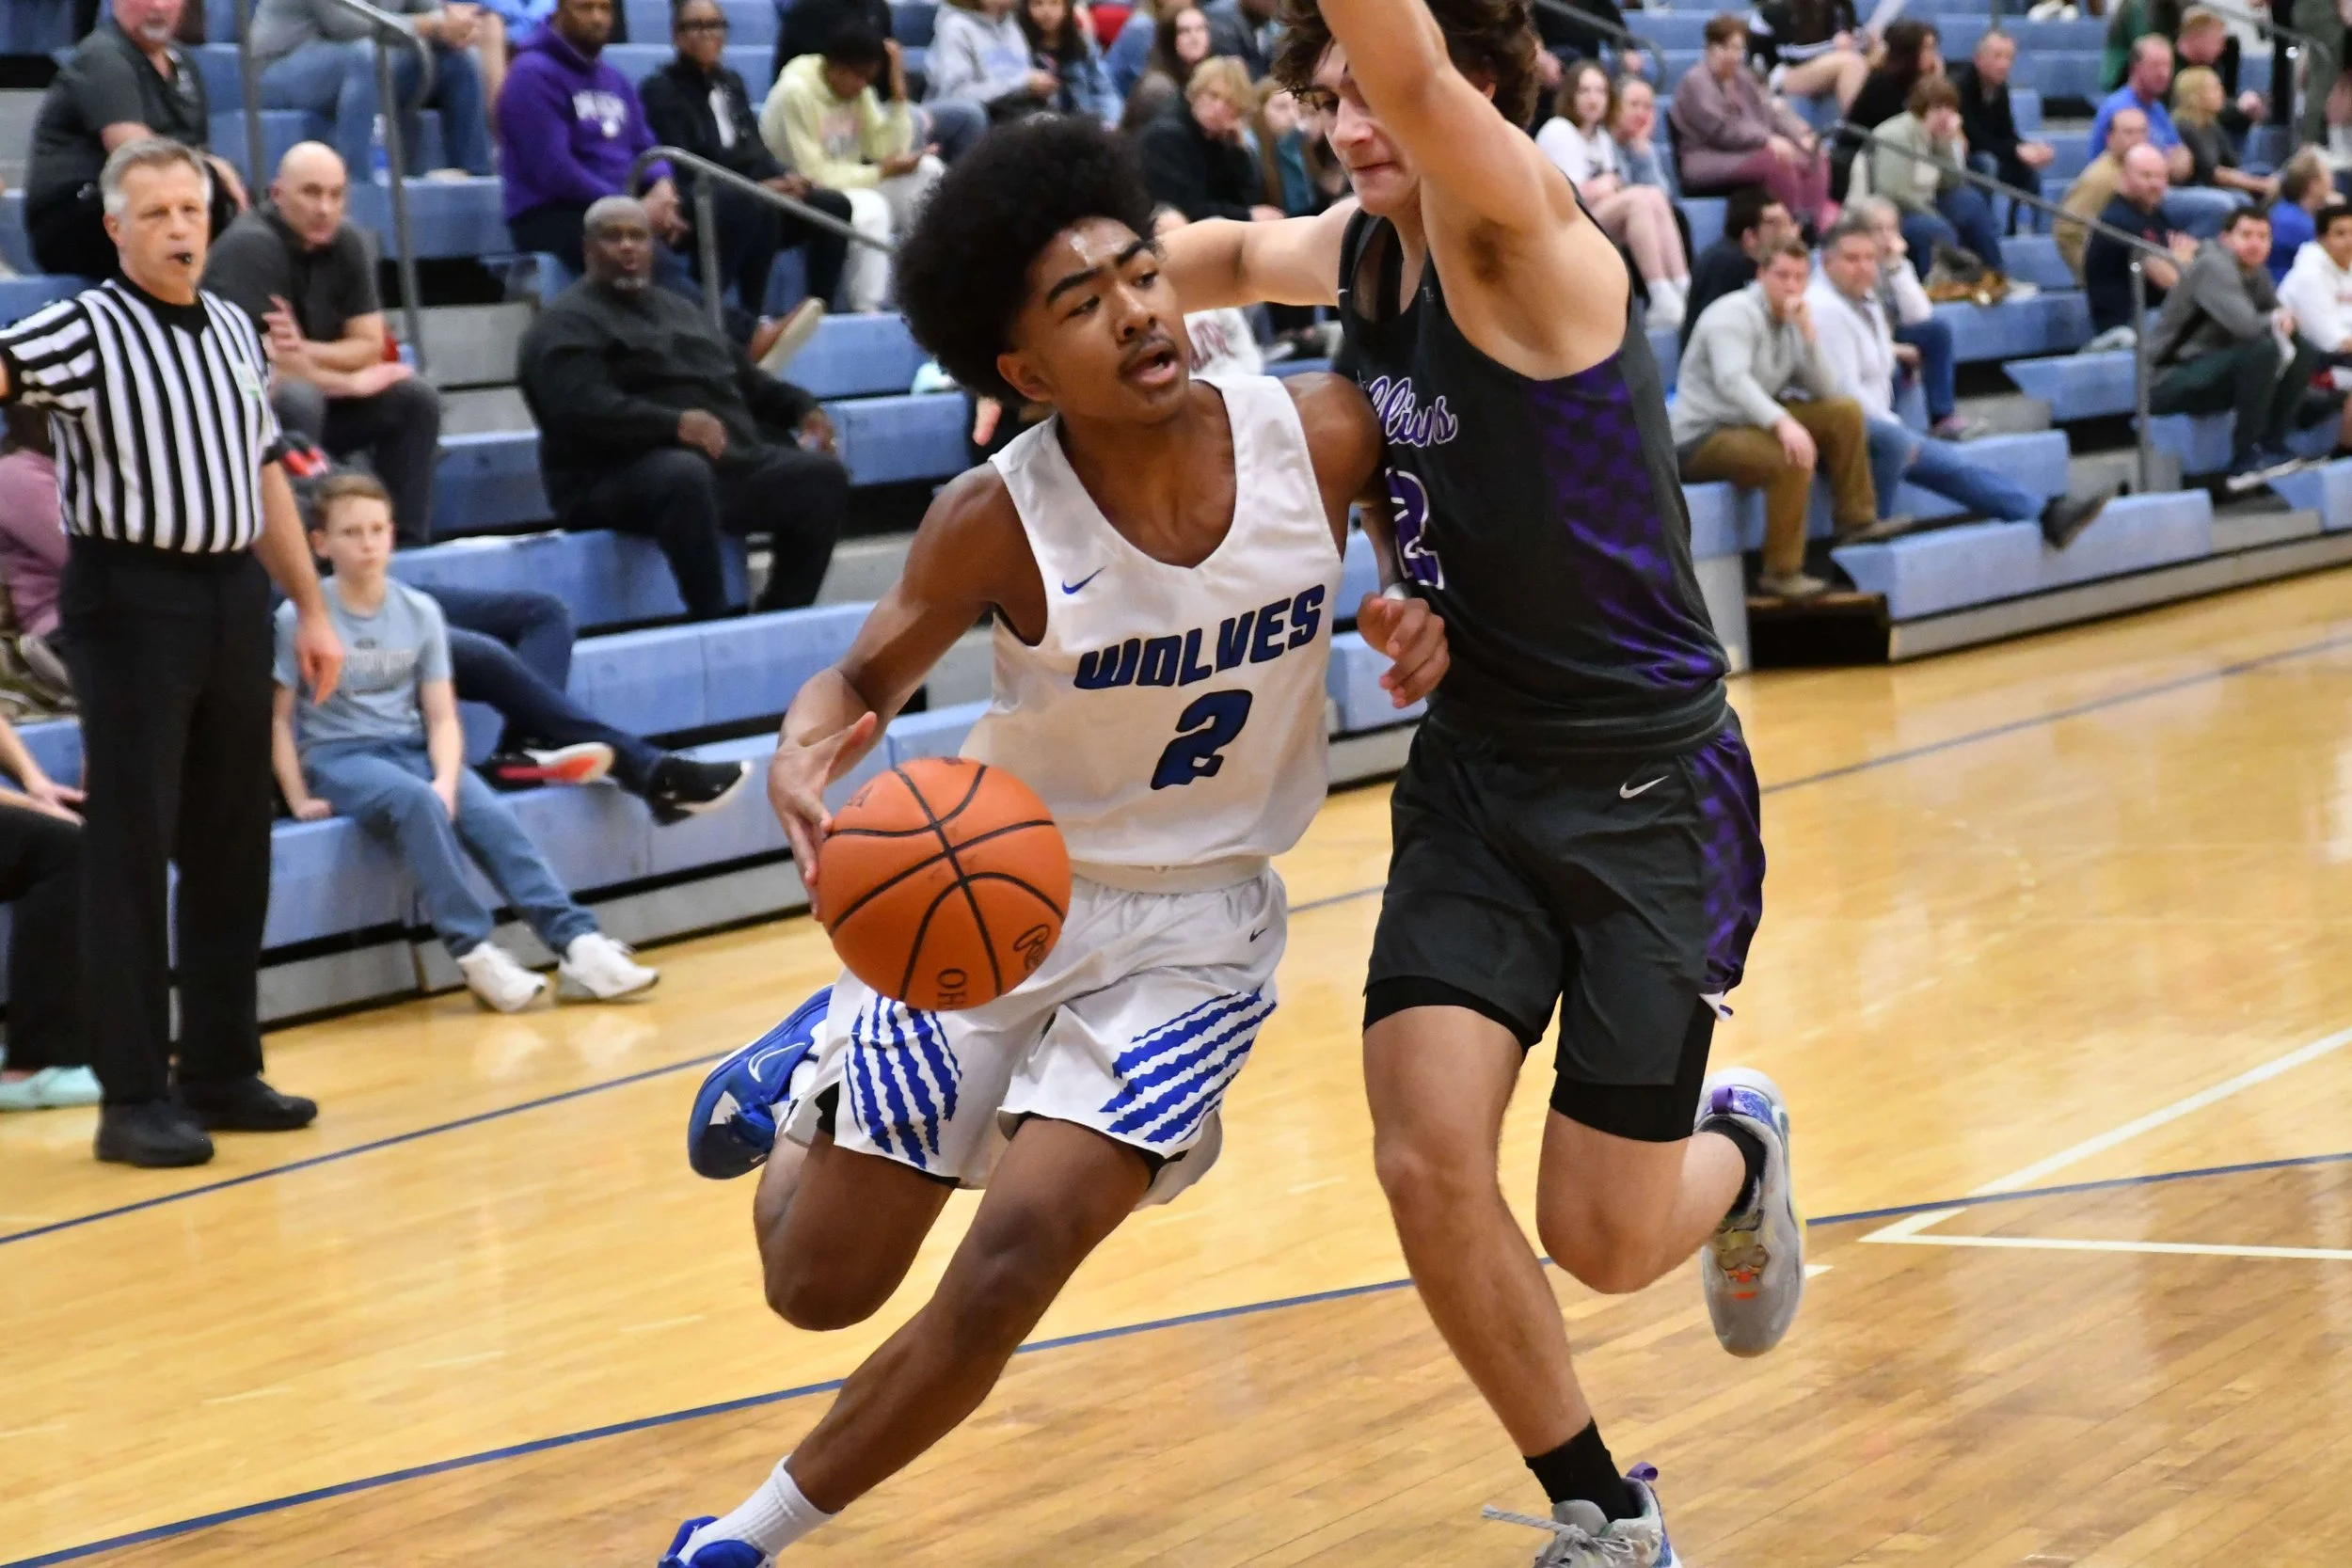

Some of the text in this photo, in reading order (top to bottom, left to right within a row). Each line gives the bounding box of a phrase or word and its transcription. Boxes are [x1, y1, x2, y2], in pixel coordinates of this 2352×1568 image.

[1367, 374, 1458, 449] llins
[1073, 583, 1326, 690] WOLVES
[1150, 689, 1253, 790] 2
